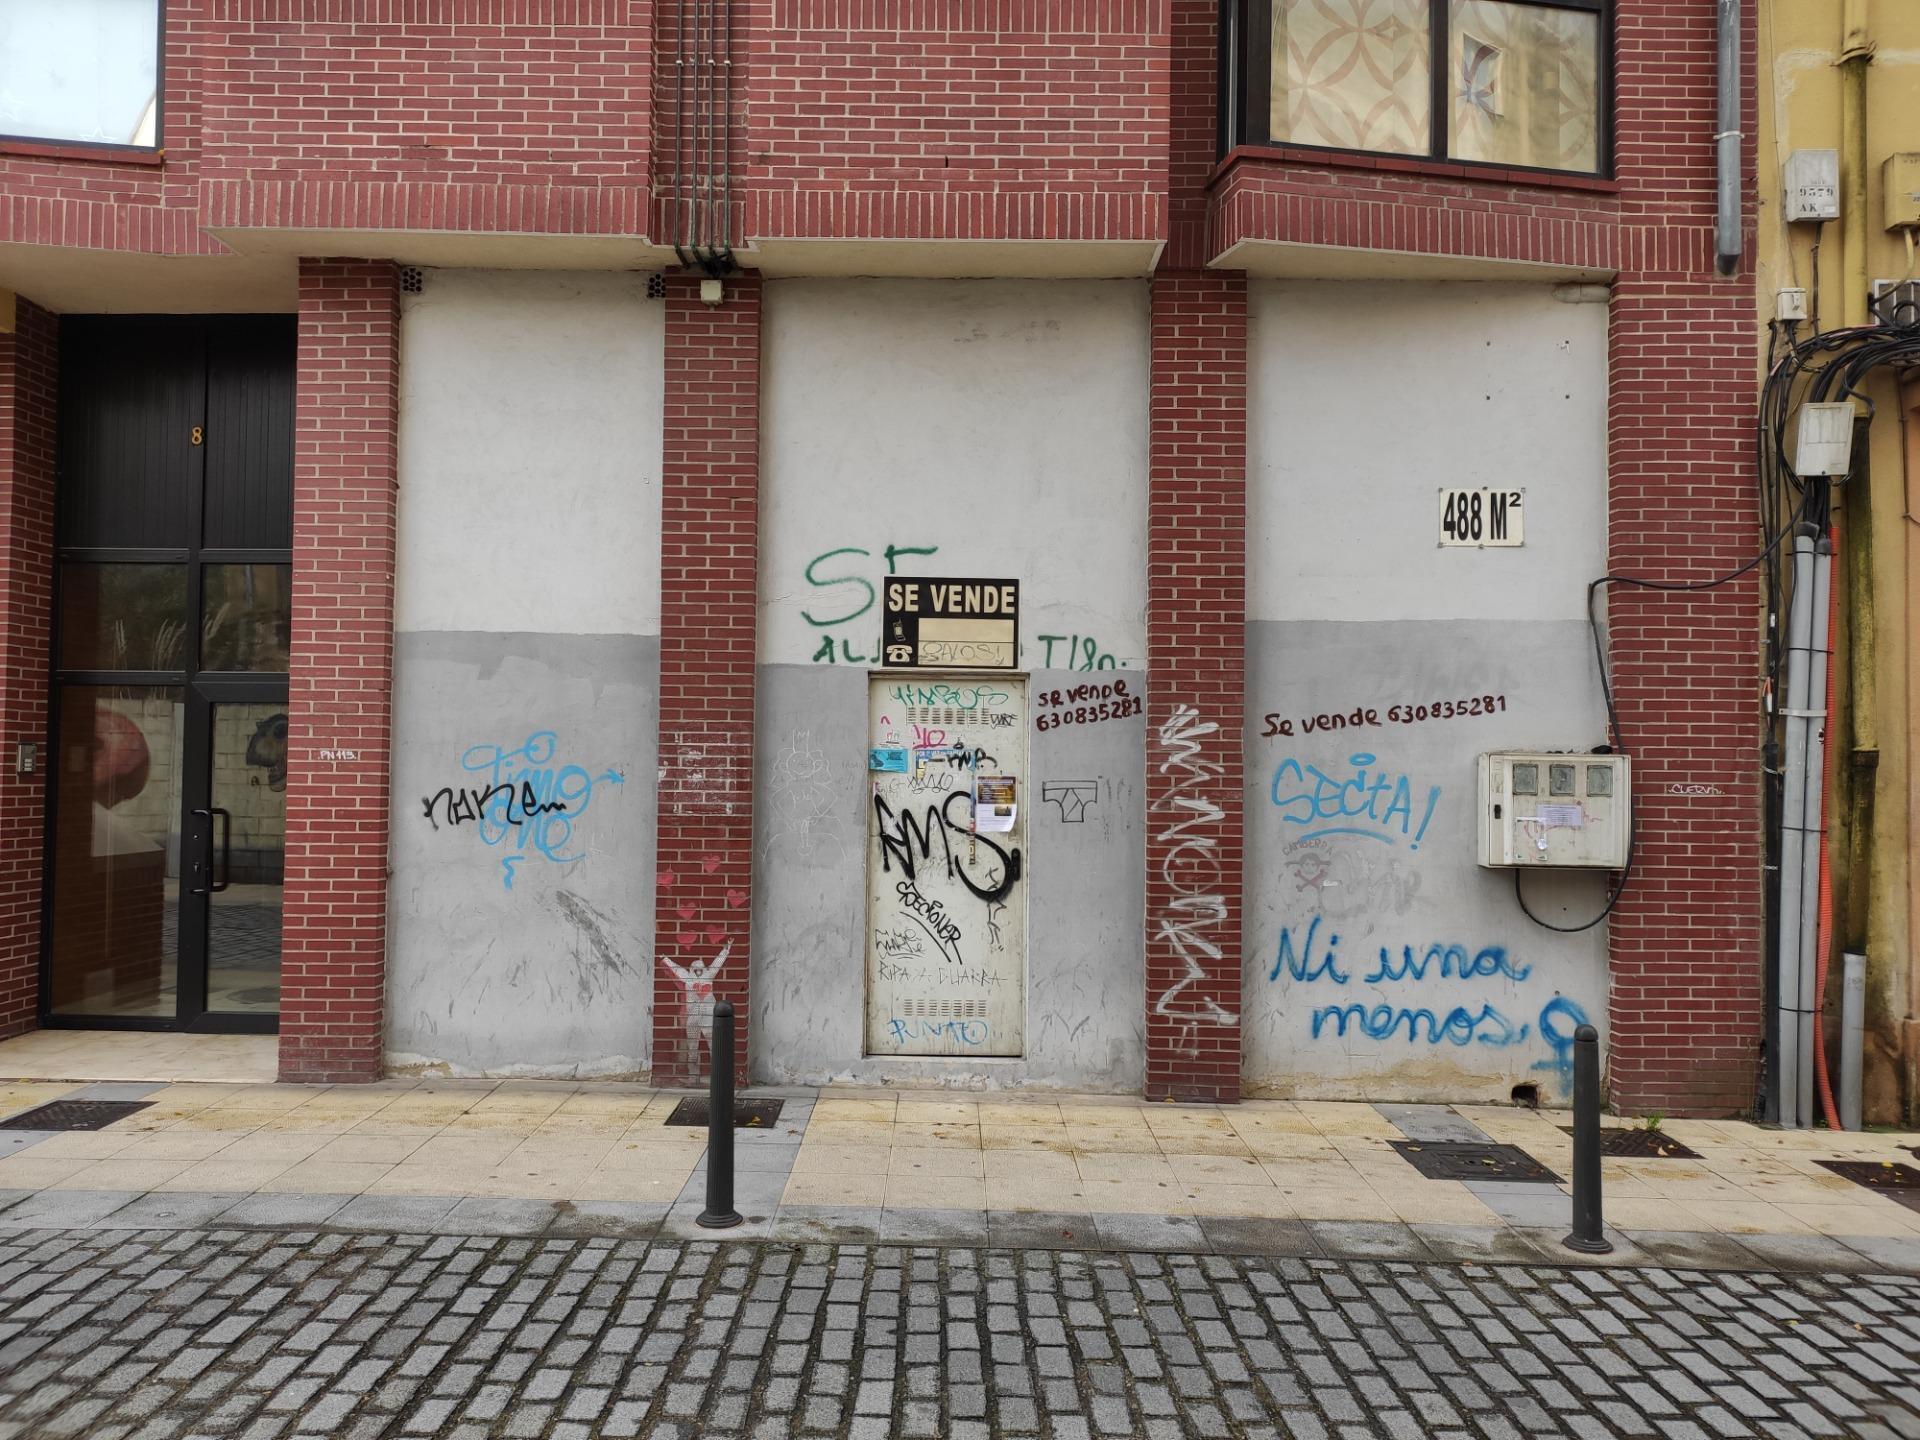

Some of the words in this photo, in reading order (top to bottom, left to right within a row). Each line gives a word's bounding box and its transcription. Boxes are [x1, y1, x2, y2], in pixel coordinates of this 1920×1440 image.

[191, 426, 203, 445] 8
[1443, 492, 1482, 541] 488
[888, 583, 919, 612] SE
[930, 584, 1016, 614] VENDE
[1036, 696, 1142, 732] 630835281
[1261, 713, 1295, 737] Se
[1302, 707, 1382, 734] vende
[1388, 695, 1506, 724] 630835281
[1269, 914, 1349, 984] Ni
[1364, 943, 1532, 982] una
[1312, 1003, 1529, 1046] menos
